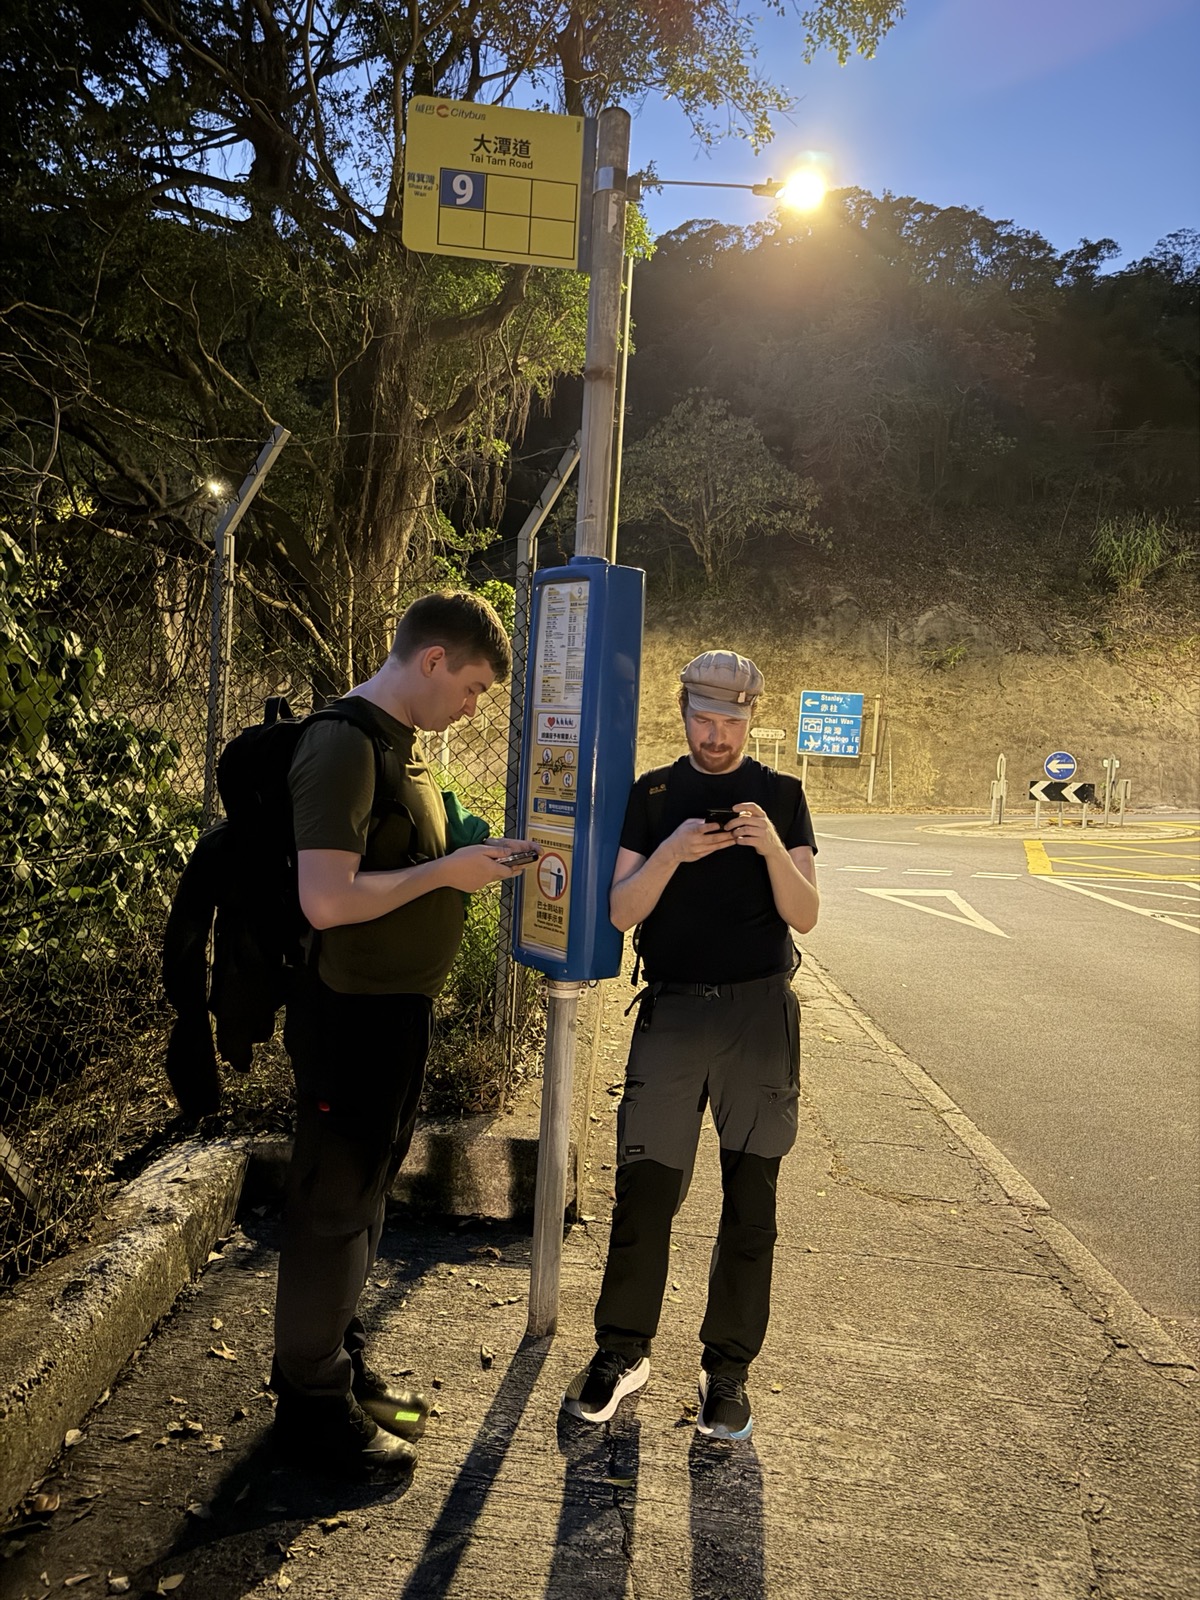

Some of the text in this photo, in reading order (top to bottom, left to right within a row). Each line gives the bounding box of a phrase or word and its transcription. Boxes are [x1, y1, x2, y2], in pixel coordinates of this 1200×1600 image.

[450, 107, 487, 121] Citybus
[473, 133, 531, 159] 大潭道
[470, 153, 533, 169] Tai Tam Road
[452, 174, 474, 206] 9
[821, 694, 844, 704] Stanley
[824, 717, 838, 725] Chai
